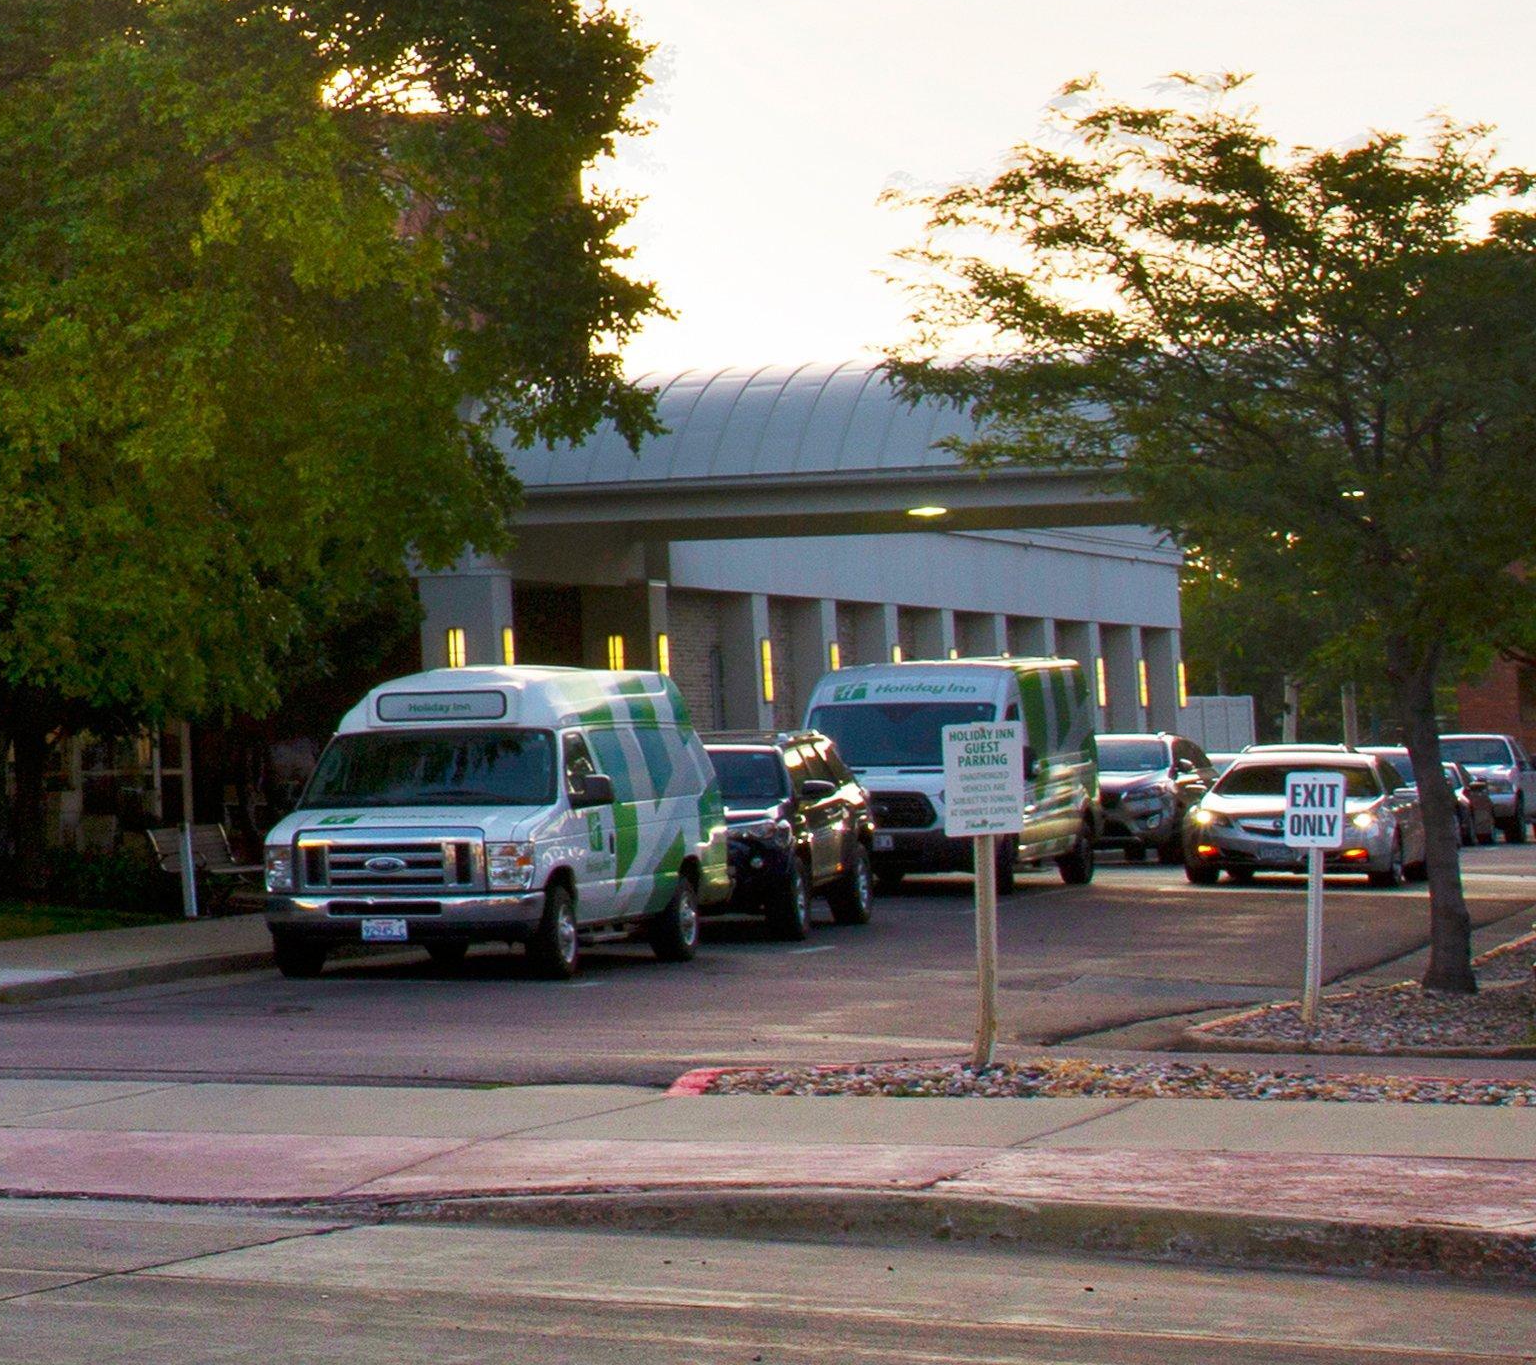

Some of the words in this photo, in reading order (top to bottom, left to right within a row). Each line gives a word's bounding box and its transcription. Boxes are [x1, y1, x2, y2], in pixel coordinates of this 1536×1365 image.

[875, 682, 944, 694] Holiday
[947, 683, 977, 694] Inn
[408, 702, 449, 714] Holiday
[948, 729, 992, 742] HOLIDAY
[995, 728, 1015, 739] INN
[964, 741, 1000, 754] GUEST
[957, 753, 1008, 767] PARKING
[1290, 783, 1339, 808] EXIT
[1289, 814, 1338, 837] ONLY
